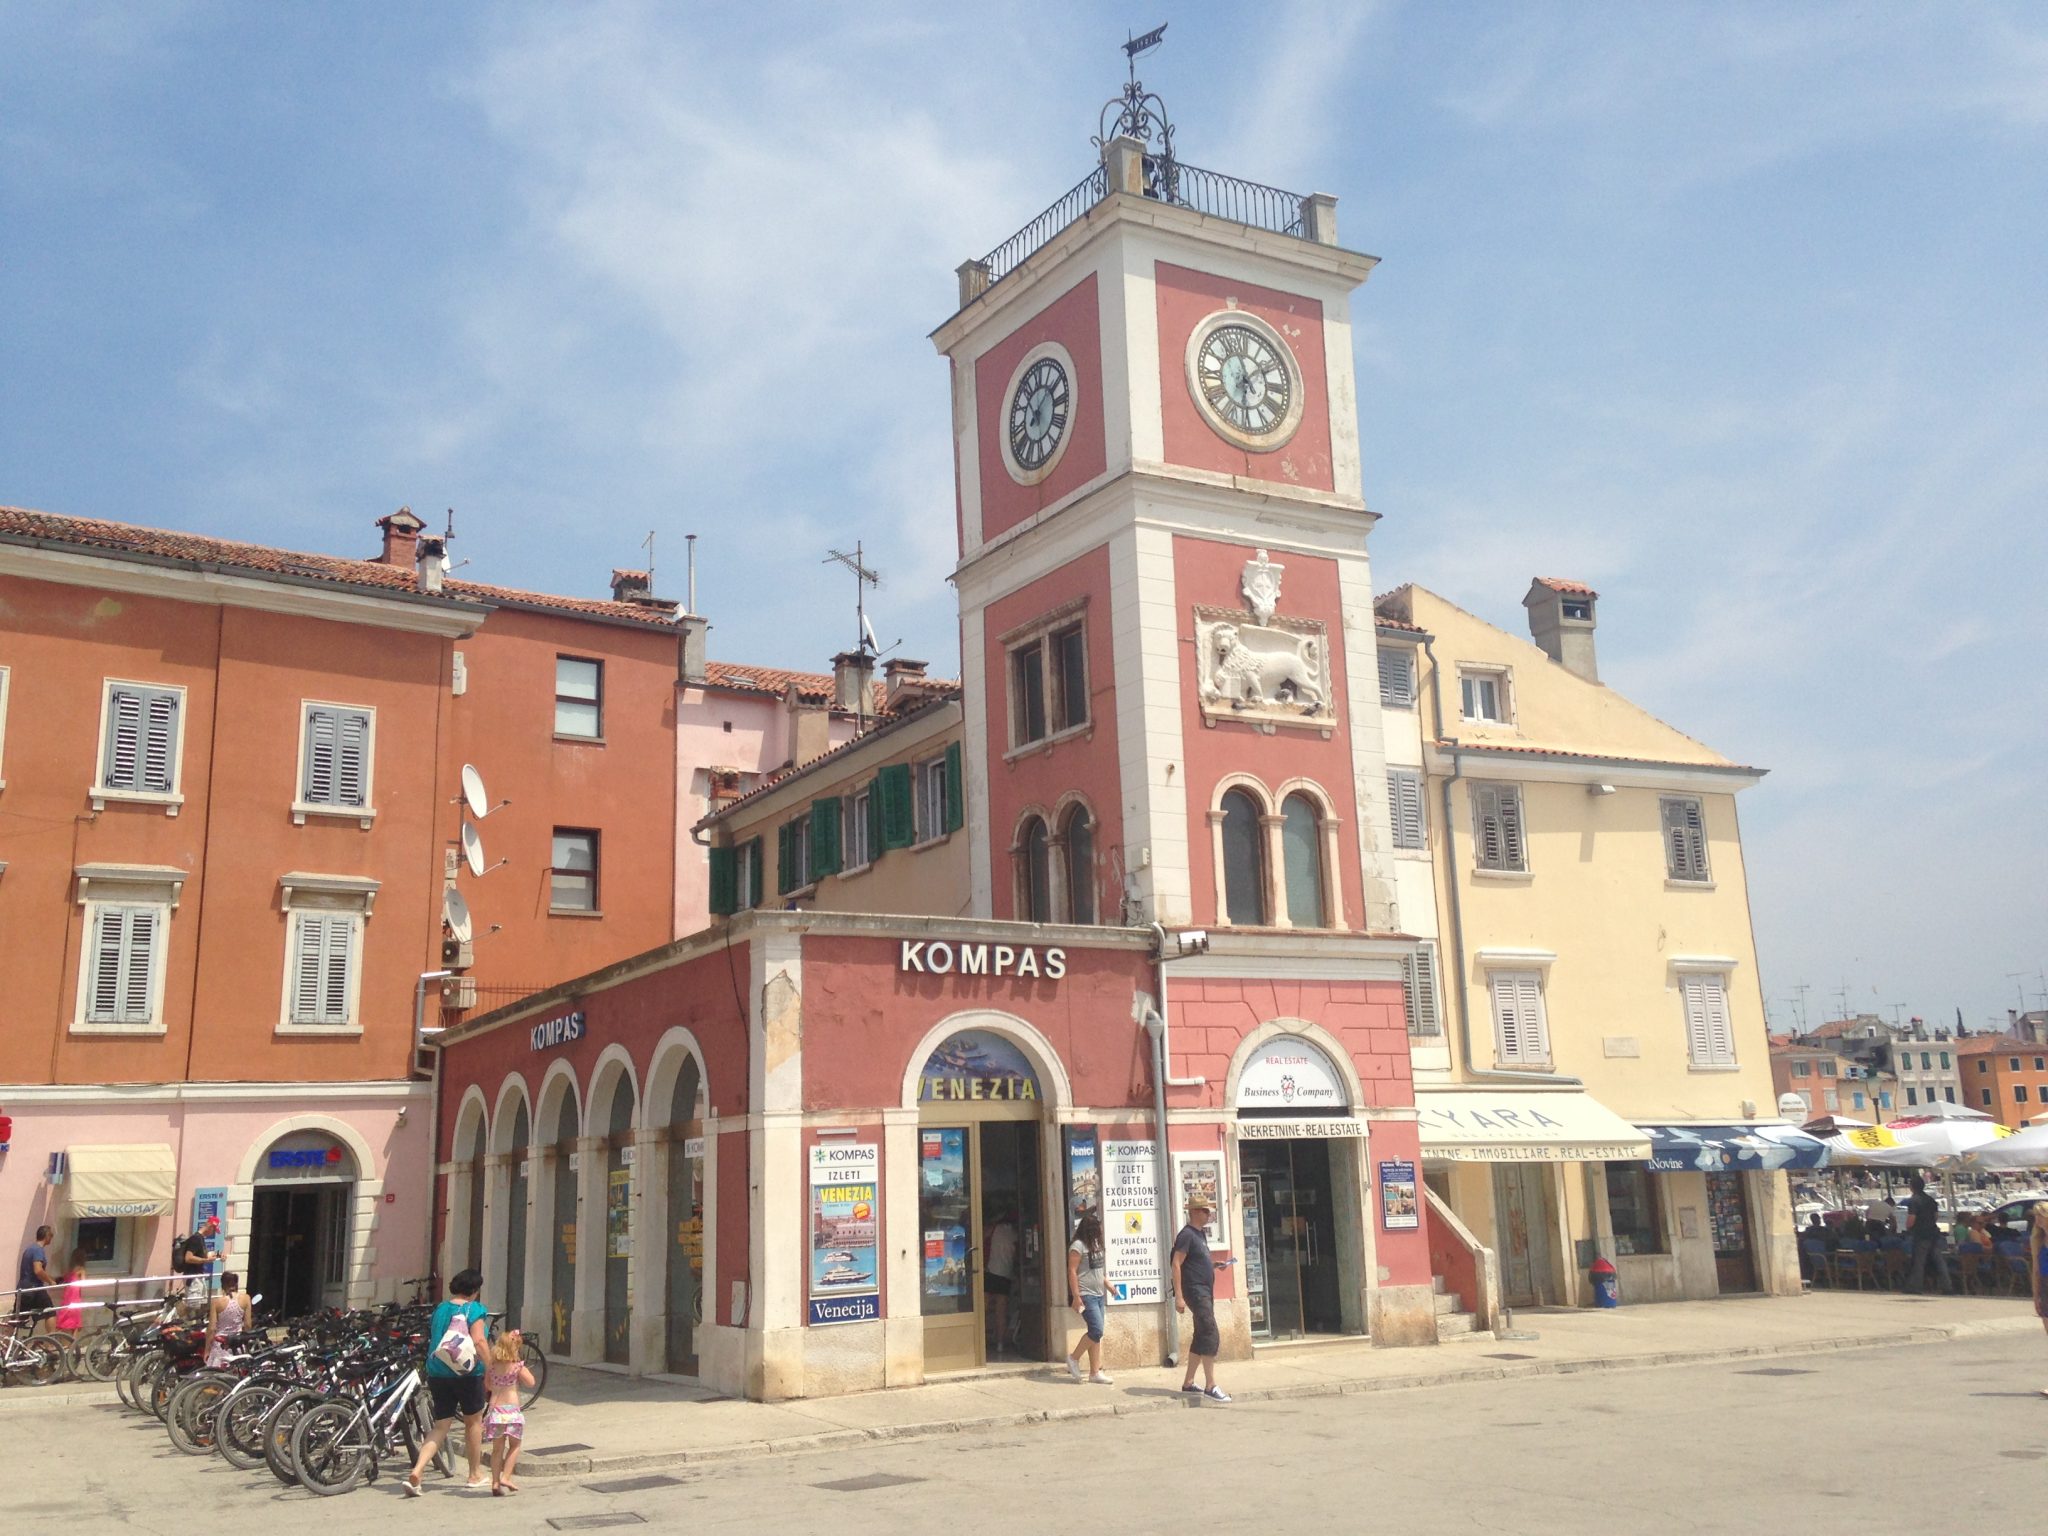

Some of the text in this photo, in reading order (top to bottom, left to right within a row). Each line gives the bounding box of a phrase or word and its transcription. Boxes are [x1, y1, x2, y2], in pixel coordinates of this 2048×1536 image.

[902, 940, 1066, 979] KOMPAS
[531, 1011, 579, 1051] KOMPAS
[1265, 1057, 1309, 1065] REAL ESTATE
[1244, 1086, 1334, 1098] Business Company
[1243, 1123, 1363, 1138] NEKRETNINE REAL ESTATE
[829, 1149, 875, 1161] KOMPAS
[1117, 1145, 1157, 1156] KOMPAS
[1471, 1147, 1551, 1160] IMMOBILIARE
[1117, 1165, 1145, 1174] IZLETI
[828, 1171, 860, 1181] IZLETI
[1121, 1176, 1141, 1185] GITE
[820, 1186, 873, 1203] VENEZIA
[1105, 1187, 1159, 1196] EXCURSIONS
[1110, 1198, 1154, 1207] AUSFLUGE
[88, 1204, 158, 1215] BANKOMAT
[1121, 1248, 1149, 1256] CAMBIO
[1116, 1258, 1152, 1266] EXCHANGE
[1108, 1269, 1161, 1278] WECHSELSTUBE
[1130, 1284, 1158, 1299] phone
[815, 1299, 875, 1319] Venecija
